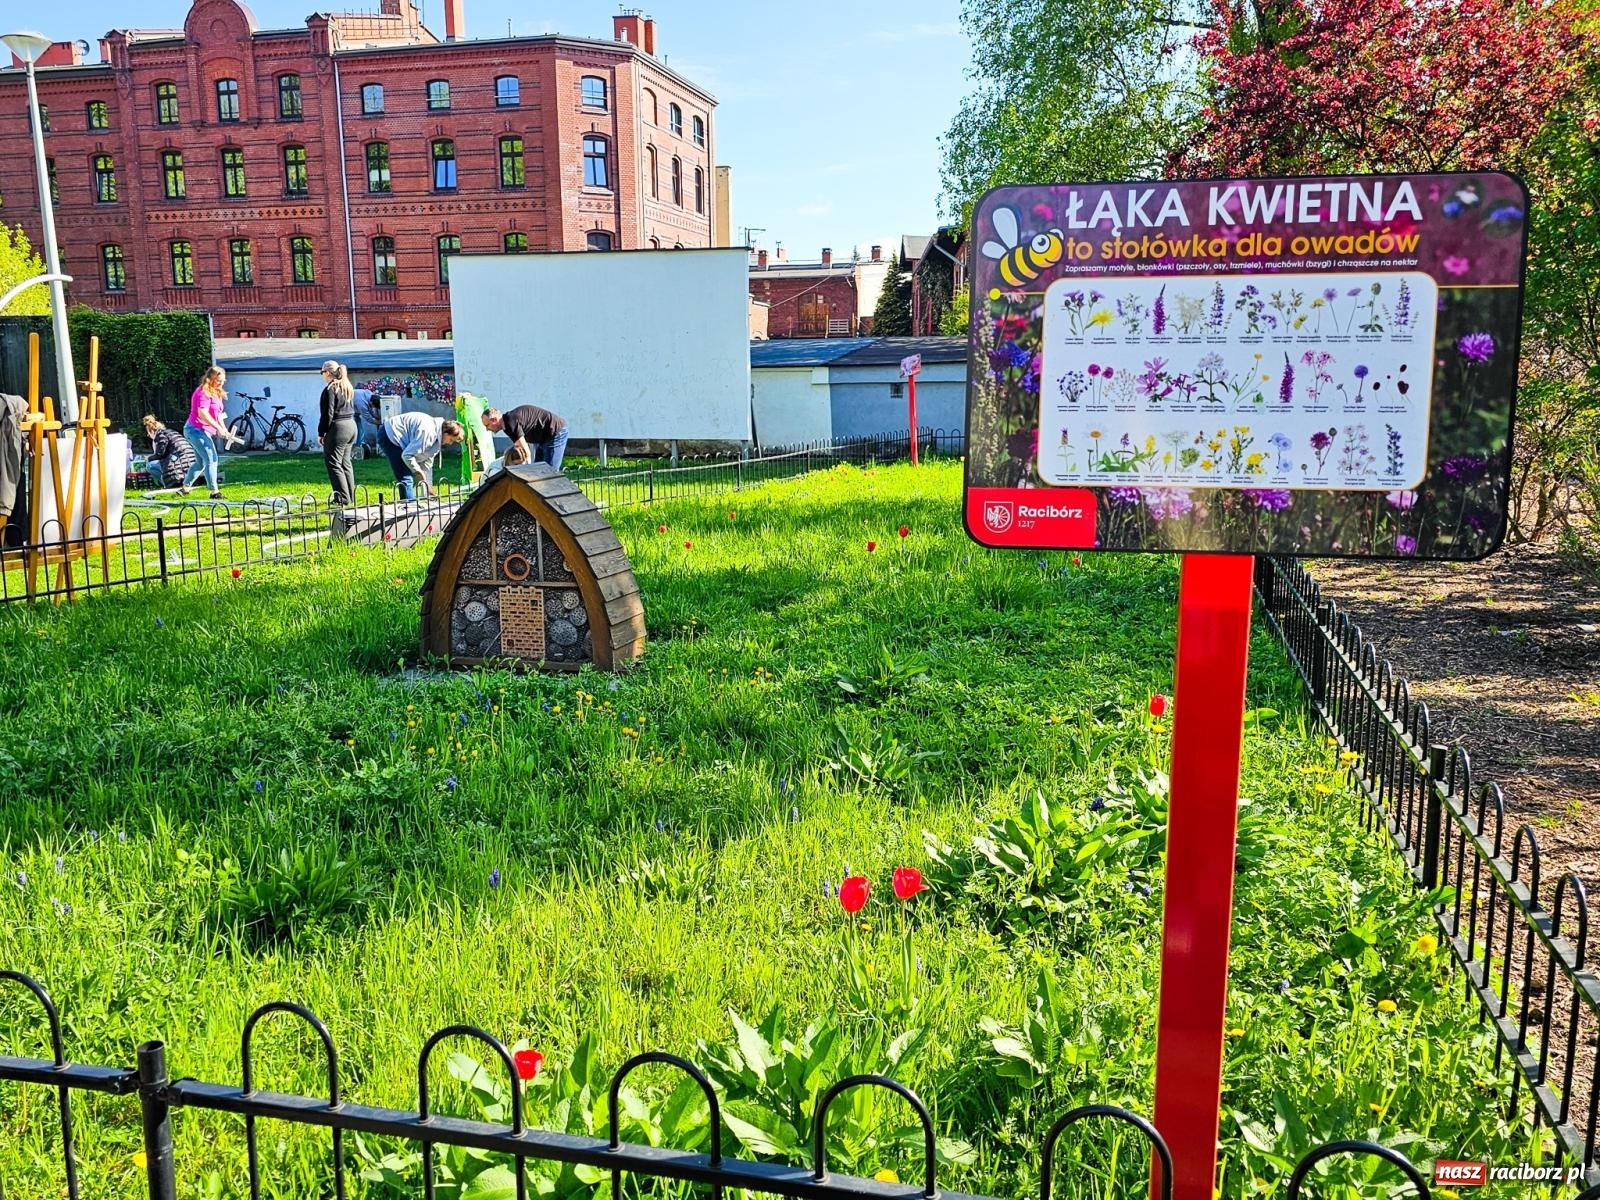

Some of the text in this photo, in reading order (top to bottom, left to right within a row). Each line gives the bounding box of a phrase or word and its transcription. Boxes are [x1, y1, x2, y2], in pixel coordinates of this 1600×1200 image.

[1065, 181, 1423, 237] ŁĄKA KWIETNA
[1066, 226, 1420, 260] to stołówka dla owadów
[1065, 264, 1108, 273] Zapraszamy
[1108, 263, 1135, 272] motyle,
[1136, 262, 1175, 271] błonkówki
[1176, 262, 1212, 271] (pszczoły,
[1213, 263, 1228, 271] osy,
[1229, 261, 1264, 270] trzmiele),
[1265, 260, 1304, 269] muchówki
[1305, 259, 1332, 269] (bzygi)
[1337, 259, 1379, 268] chrząszcze
[1380, 259, 1391, 267] na
[1392, 258, 1419, 267] nektar
[1018, 505, 1083, 519] Racibórz
[1018, 520, 1036, 530] 1217
